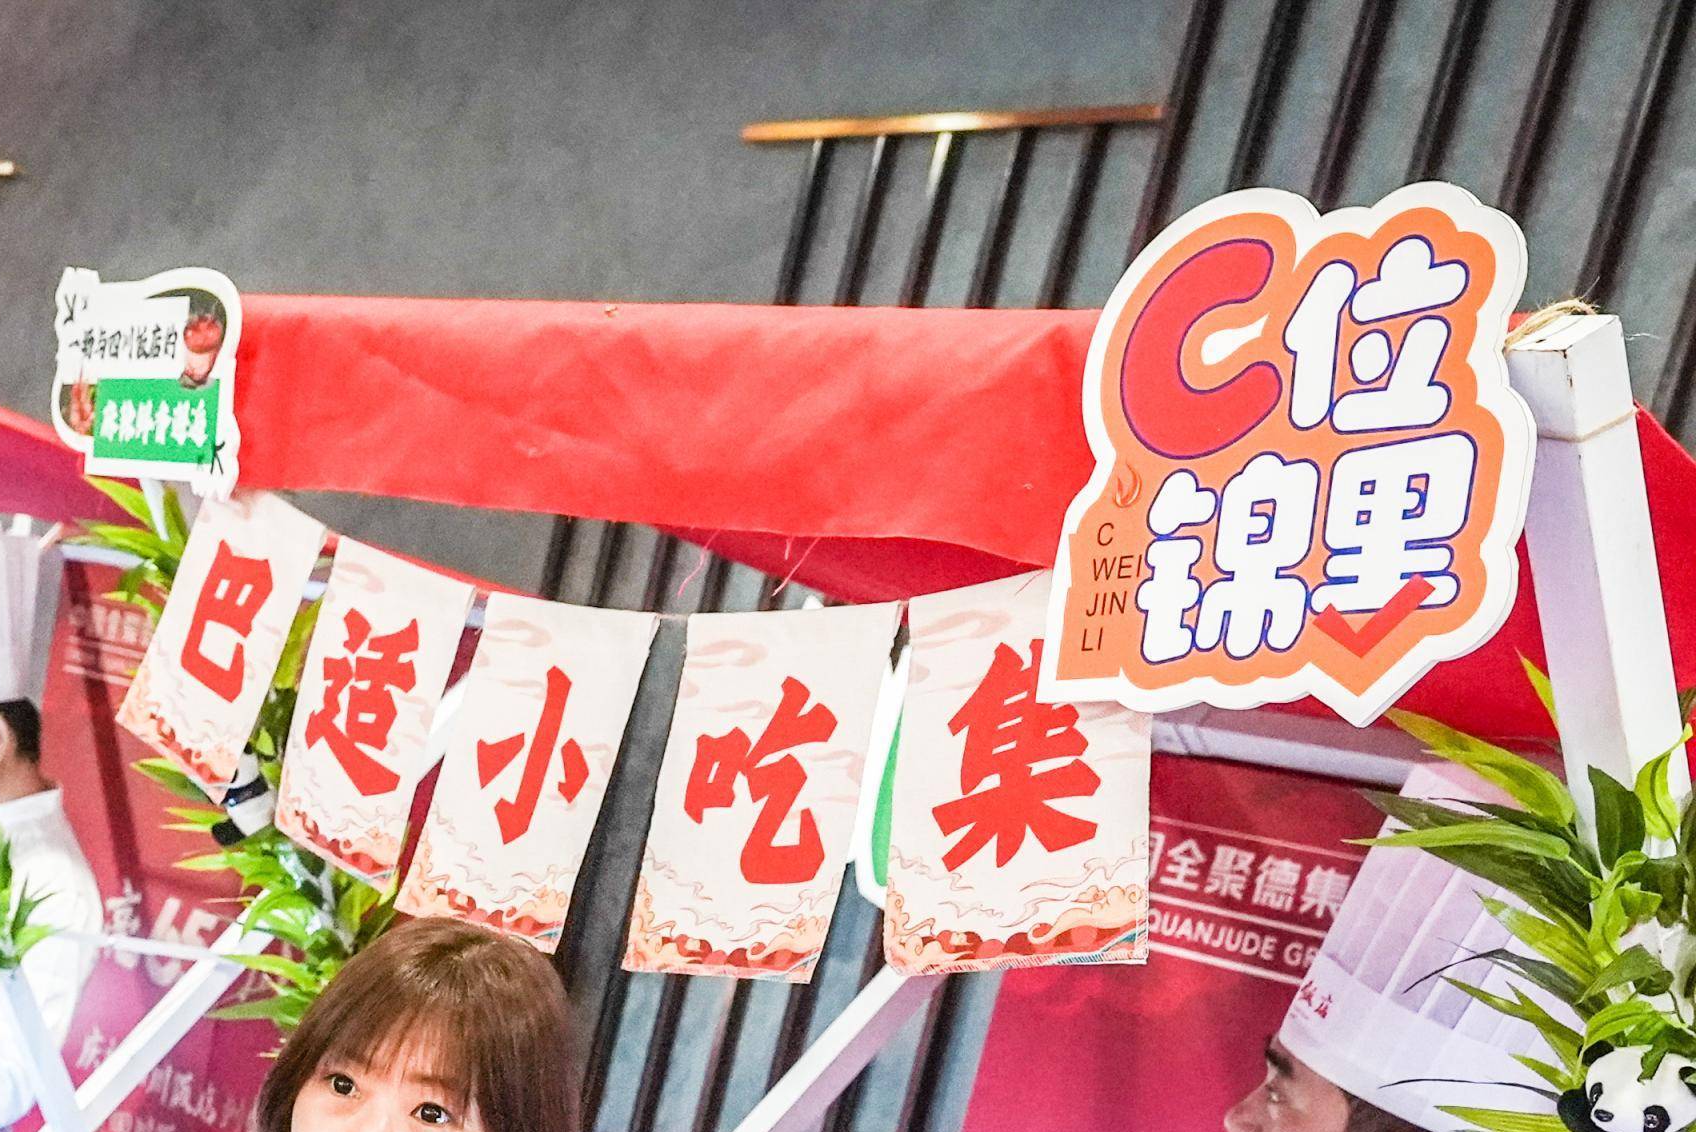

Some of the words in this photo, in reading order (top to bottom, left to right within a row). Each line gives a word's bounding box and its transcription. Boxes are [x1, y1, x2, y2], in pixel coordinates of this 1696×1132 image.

[1120, 234, 1470, 462] C位
[1096, 521, 1115, 547] C
[1135, 431, 1479, 664] 锦里
[1092, 555, 1144, 581] WEI
[1084, 591, 1128, 618] JIN
[1081, 627, 1104, 652] LI
[1148, 912, 1278, 961] QUANJUDE
